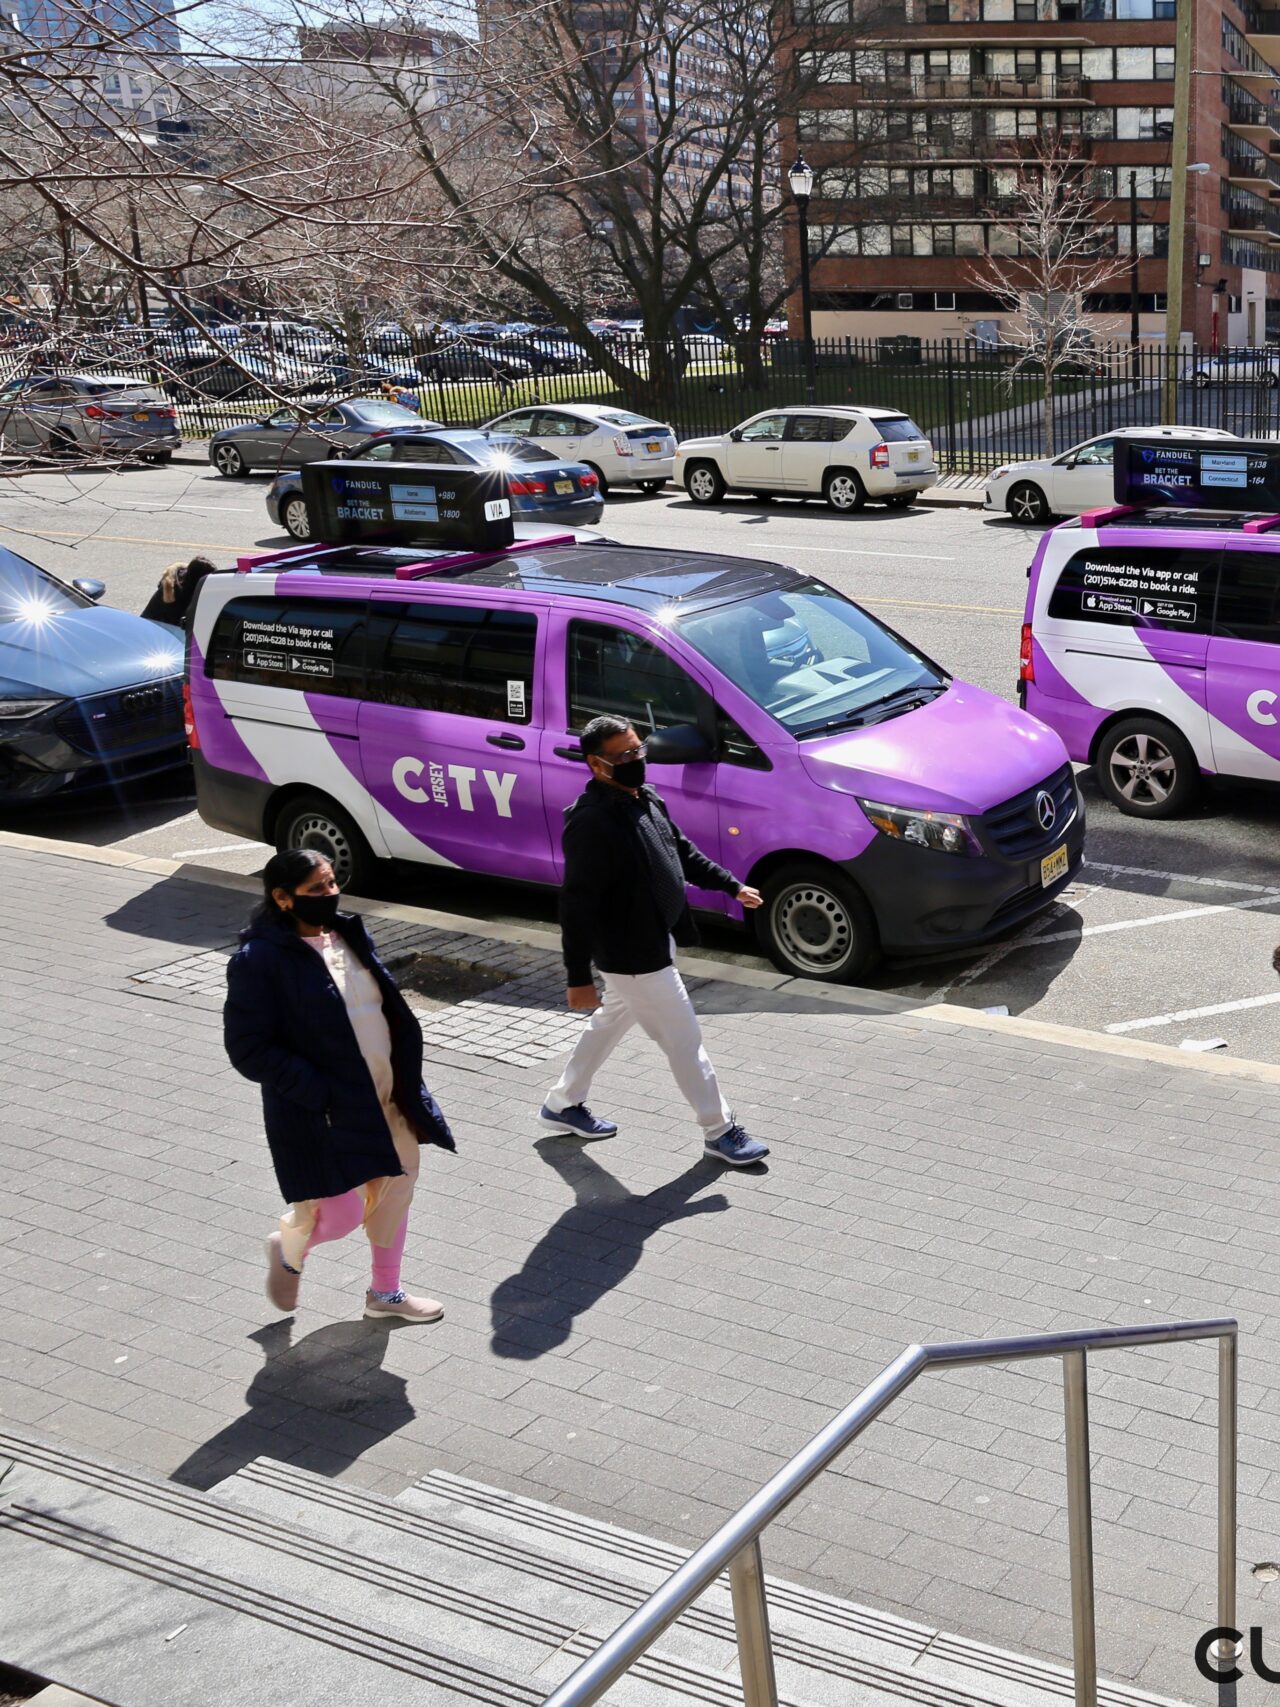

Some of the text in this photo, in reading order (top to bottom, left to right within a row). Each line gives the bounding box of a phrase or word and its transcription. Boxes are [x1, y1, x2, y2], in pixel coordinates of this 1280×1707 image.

[1156, 451, 1193, 460] FANDUEL
[1249, 461, 1267, 469] +138
[345, 480, 382, 490] FANDUEL
[1143, 474, 1192, 486] BRACKET
[1248, 476, 1265, 484] -164
[438, 491, 456, 500] +980
[337, 506, 384, 520] BRACKET
[439, 510, 460, 519] -1800
[490, 503, 504, 518] VIA
[1085, 562, 1198, 582] Download the Via app or call
[1083, 574, 1138, 588] (201)514-6228
[1140, 580, 1148, 589] to
[1150, 581, 1170, 592] book
[1179, 585, 1198, 595] ride.
[1098, 601, 1133, 612] App Store
[1157, 607, 1190, 619] Google Play
[243, 621, 274, 632] Download
[276, 624, 287, 633] the
[288, 626, 298, 634] Via
[299, 628, 311, 638] app
[321, 629, 333, 638] call
[243, 632, 286, 645] (201)514-6228
[287, 637, 294, 646] to
[296, 638, 311, 648] book
[318, 642, 333, 650] ride.
[257, 658, 283, 668] App Store
[302, 663, 329, 673] Google Play
[429, 761, 448, 807] JERSEY
